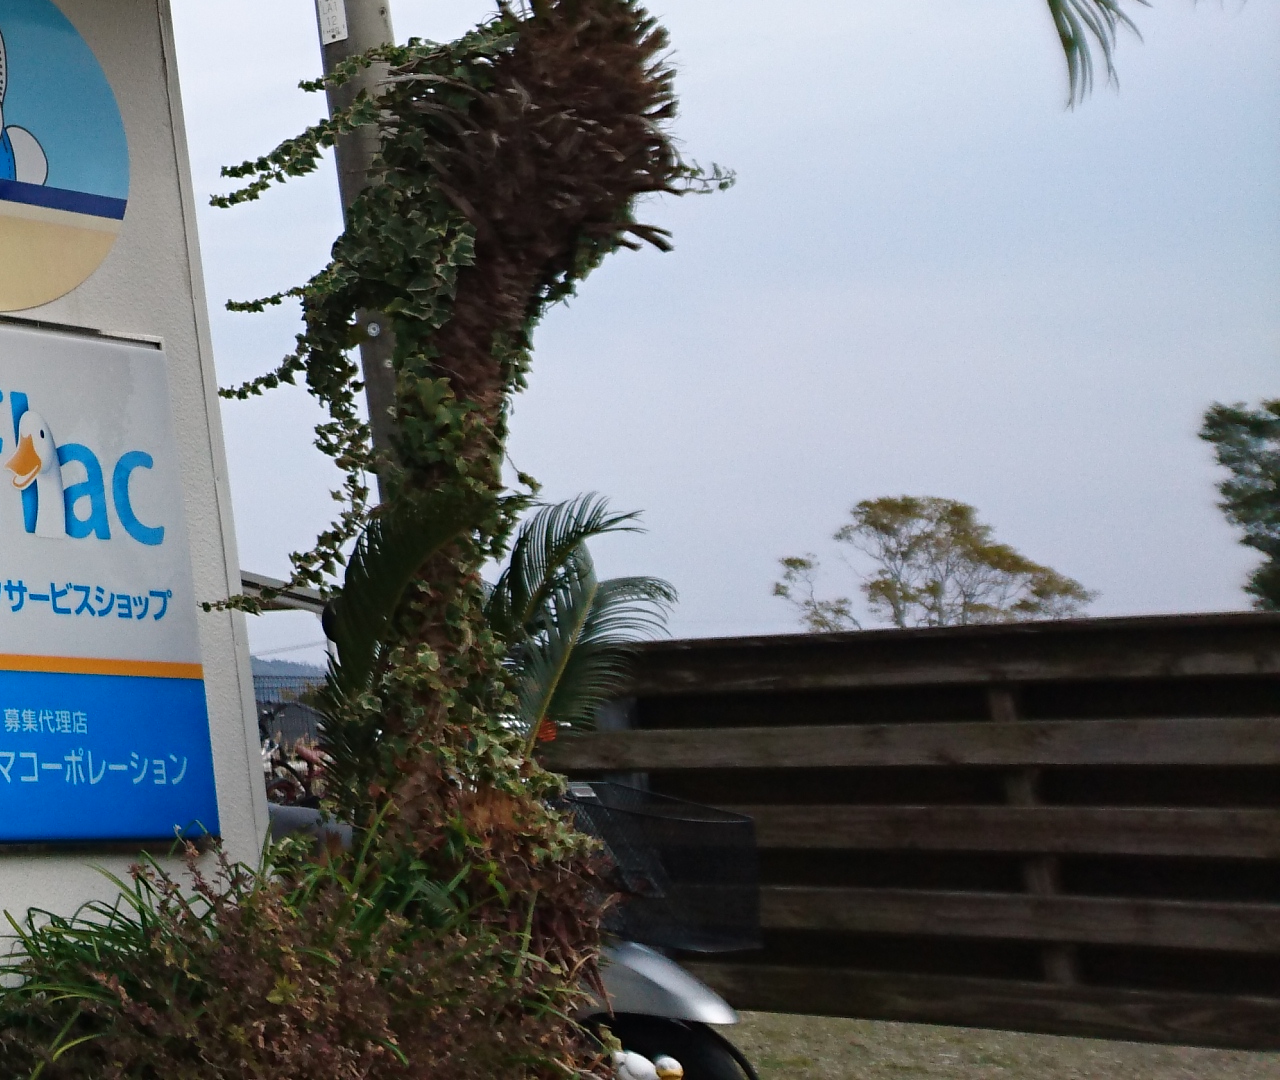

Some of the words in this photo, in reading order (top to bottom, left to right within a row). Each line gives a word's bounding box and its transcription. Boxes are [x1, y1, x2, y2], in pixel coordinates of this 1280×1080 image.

[3, 707, 89, 735] 募集代理店
